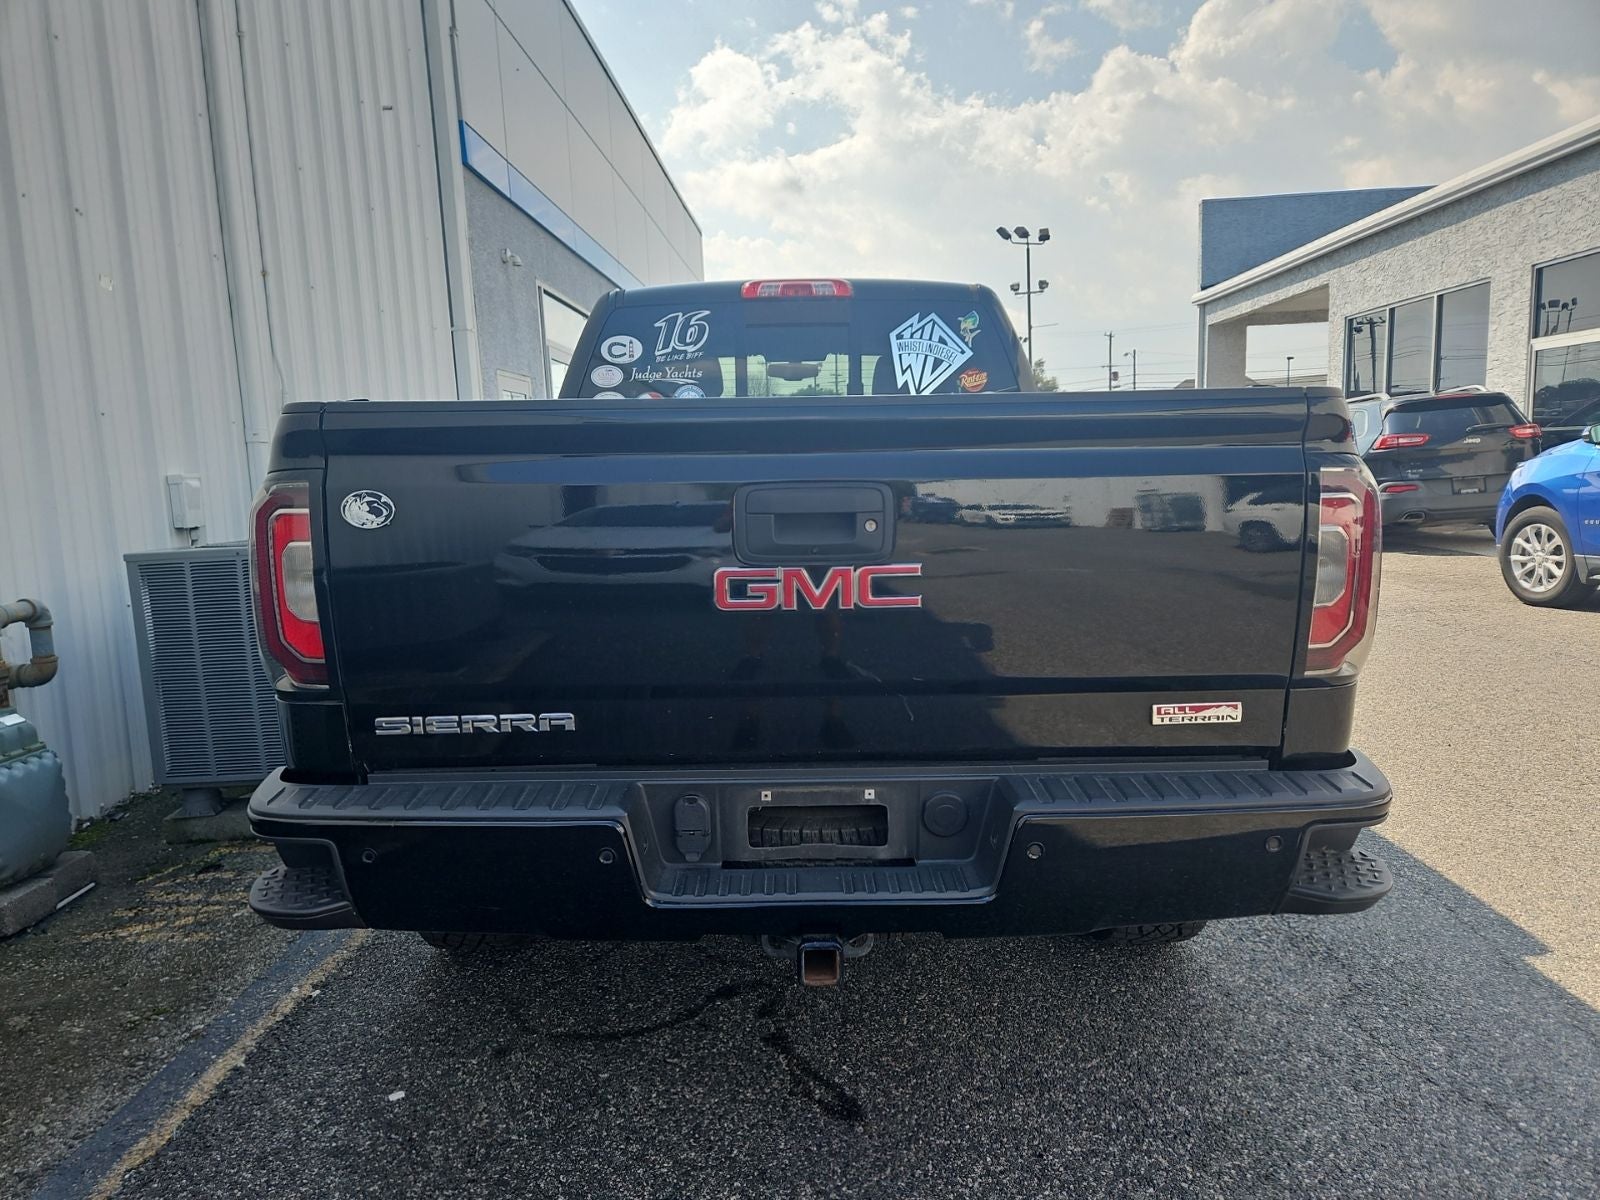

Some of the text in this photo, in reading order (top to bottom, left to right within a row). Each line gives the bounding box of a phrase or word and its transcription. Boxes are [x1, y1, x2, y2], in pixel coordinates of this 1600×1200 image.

[654, 310, 711, 355] 16
[655, 351, 704, 363] BE LIKE BIFF
[896, 341, 958, 363] WHISTLINDIESEL
[629, 365, 662, 383] Judge
[665, 364, 703, 379] Yachts
[1463, 436, 1481, 444] Jeep
[713, 563, 922, 611] GMC
[1157, 714, 1238, 723] TERRAIN
[1160, 706, 1196, 716] ALL
[374, 712, 576, 736] SIERRA
